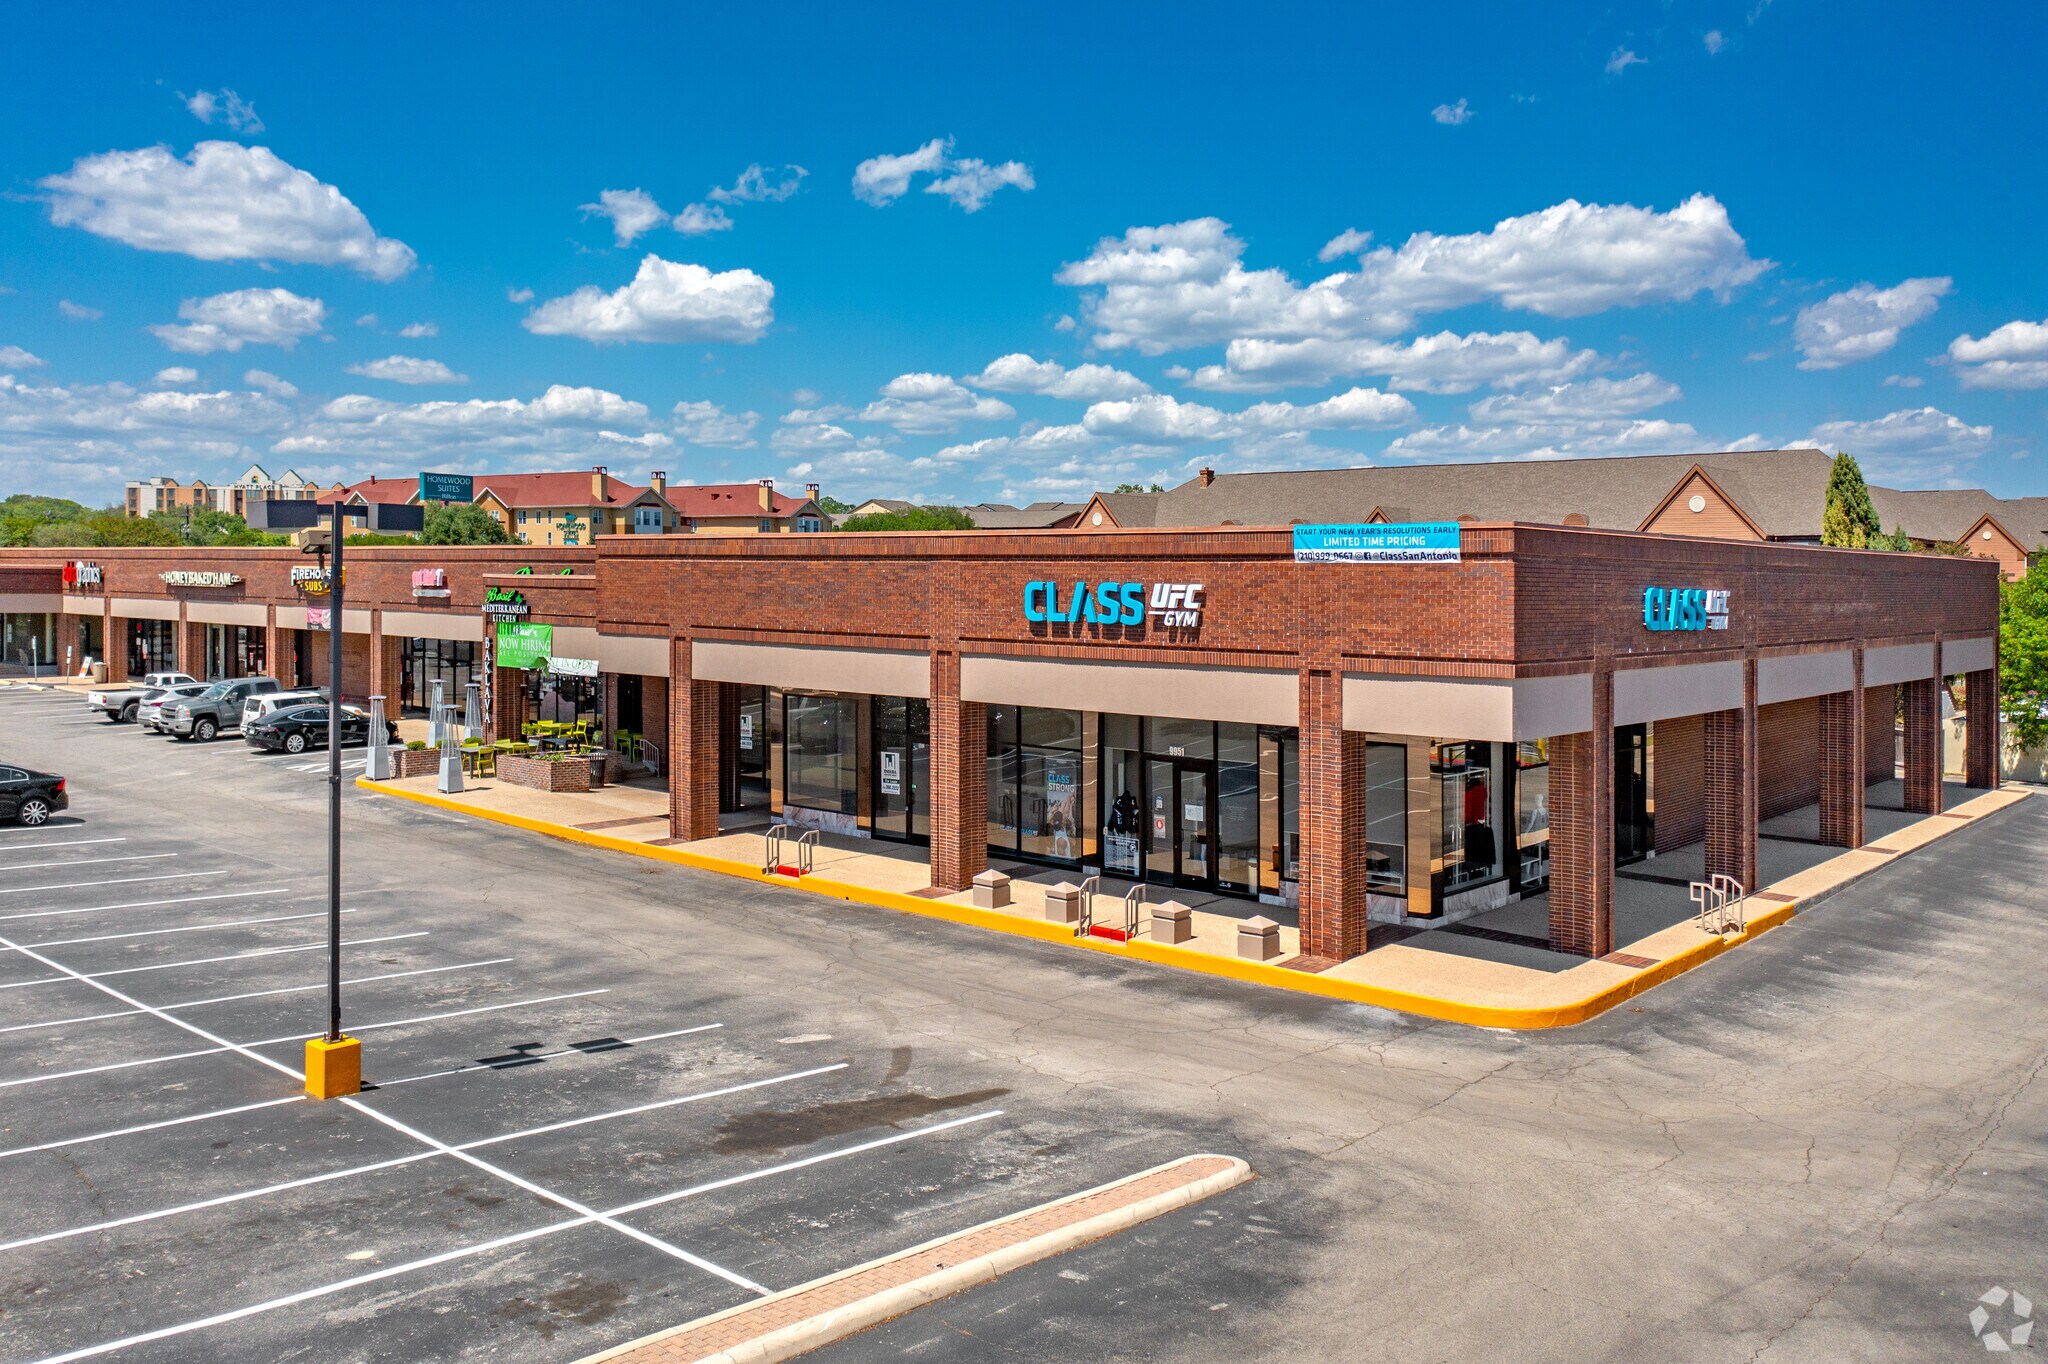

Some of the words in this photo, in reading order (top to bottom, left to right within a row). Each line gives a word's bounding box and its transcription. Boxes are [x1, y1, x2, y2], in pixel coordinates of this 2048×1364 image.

[426, 475, 471, 485] HOMEWOOD
[437, 484, 461, 493] SUITES
[1296, 528, 1317, 536] START
[1338, 527, 1354, 535] NEW
[1356, 527, 1381, 535] YEAR'S
[1383, 526, 1431, 535] RESOLUTIONS
[1433, 526, 1456, 534] EARLY
[1323, 537, 1360, 547] LIMITED
[1362, 536, 1385, 546] TIME
[1387, 536, 1426, 546] PRICING
[213, 572, 231, 586] HAM
[304, 581, 323, 591] SUBS
[485, 587, 516, 603] Basil
[1023, 581, 1146, 626] CLASS
[1150, 583, 1205, 609] UFC
[1644, 587, 1708, 631] CLASS
[481, 604, 528, 615] MEDITERRANEAN
[492, 615, 517, 623] KITCHEN
[1163, 611, 1198, 628] GYM
[499, 637, 519, 650] NOW
[521, 639, 552, 653] HIRING
[484, 636, 492, 724] BAKLAVA
[1047, 773, 1070, 784] CLASS
[1048, 782, 1075, 793] STRONG
